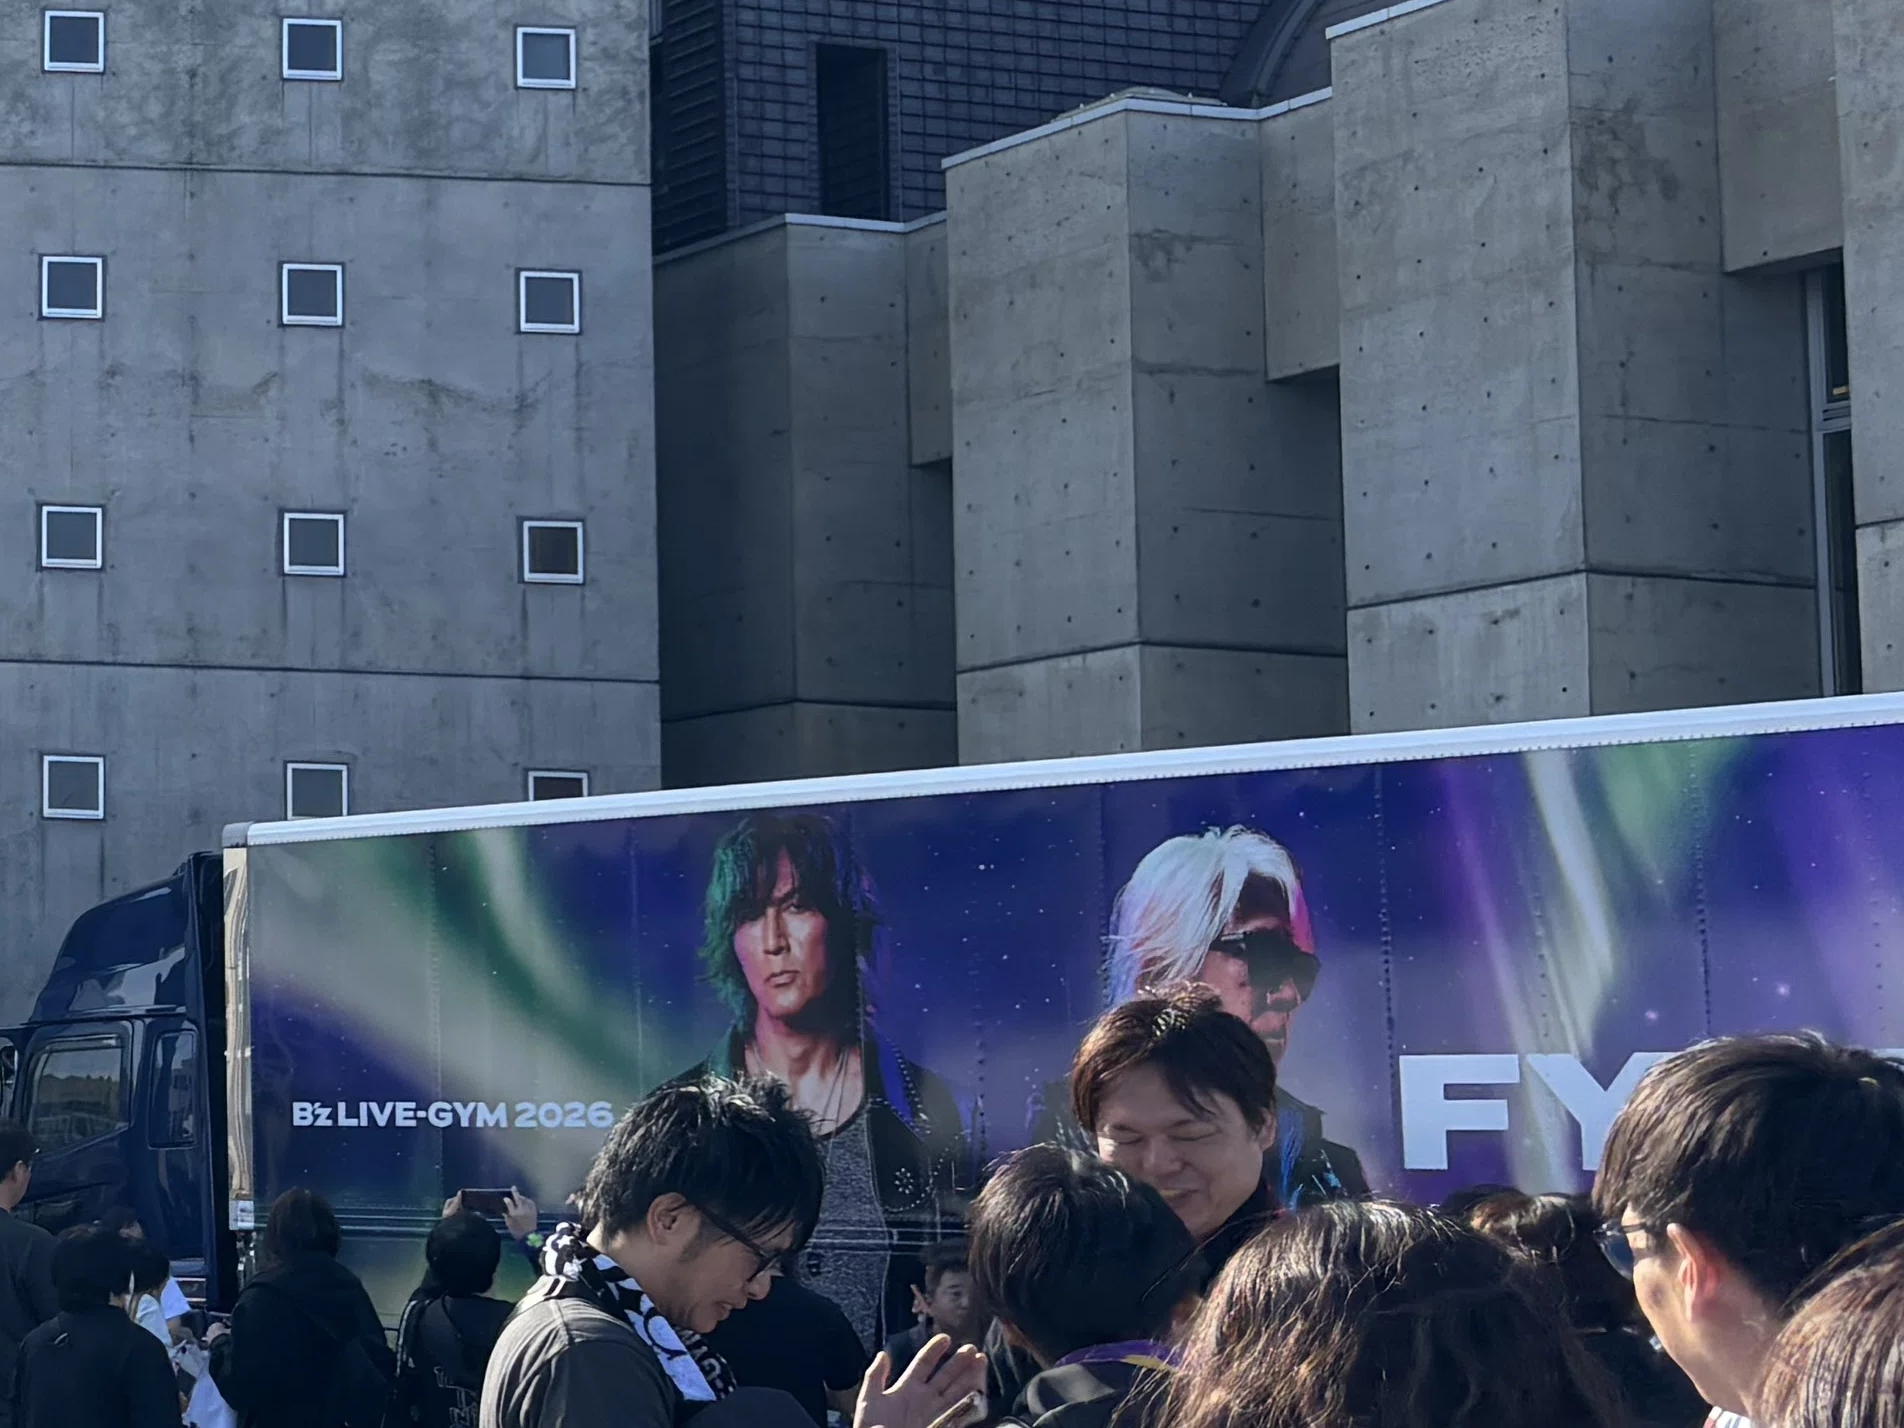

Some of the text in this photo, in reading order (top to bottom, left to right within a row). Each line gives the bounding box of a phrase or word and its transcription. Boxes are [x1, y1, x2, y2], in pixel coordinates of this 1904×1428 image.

[292, 1101, 613, 1128] B'z LIVE-GYM 2026
